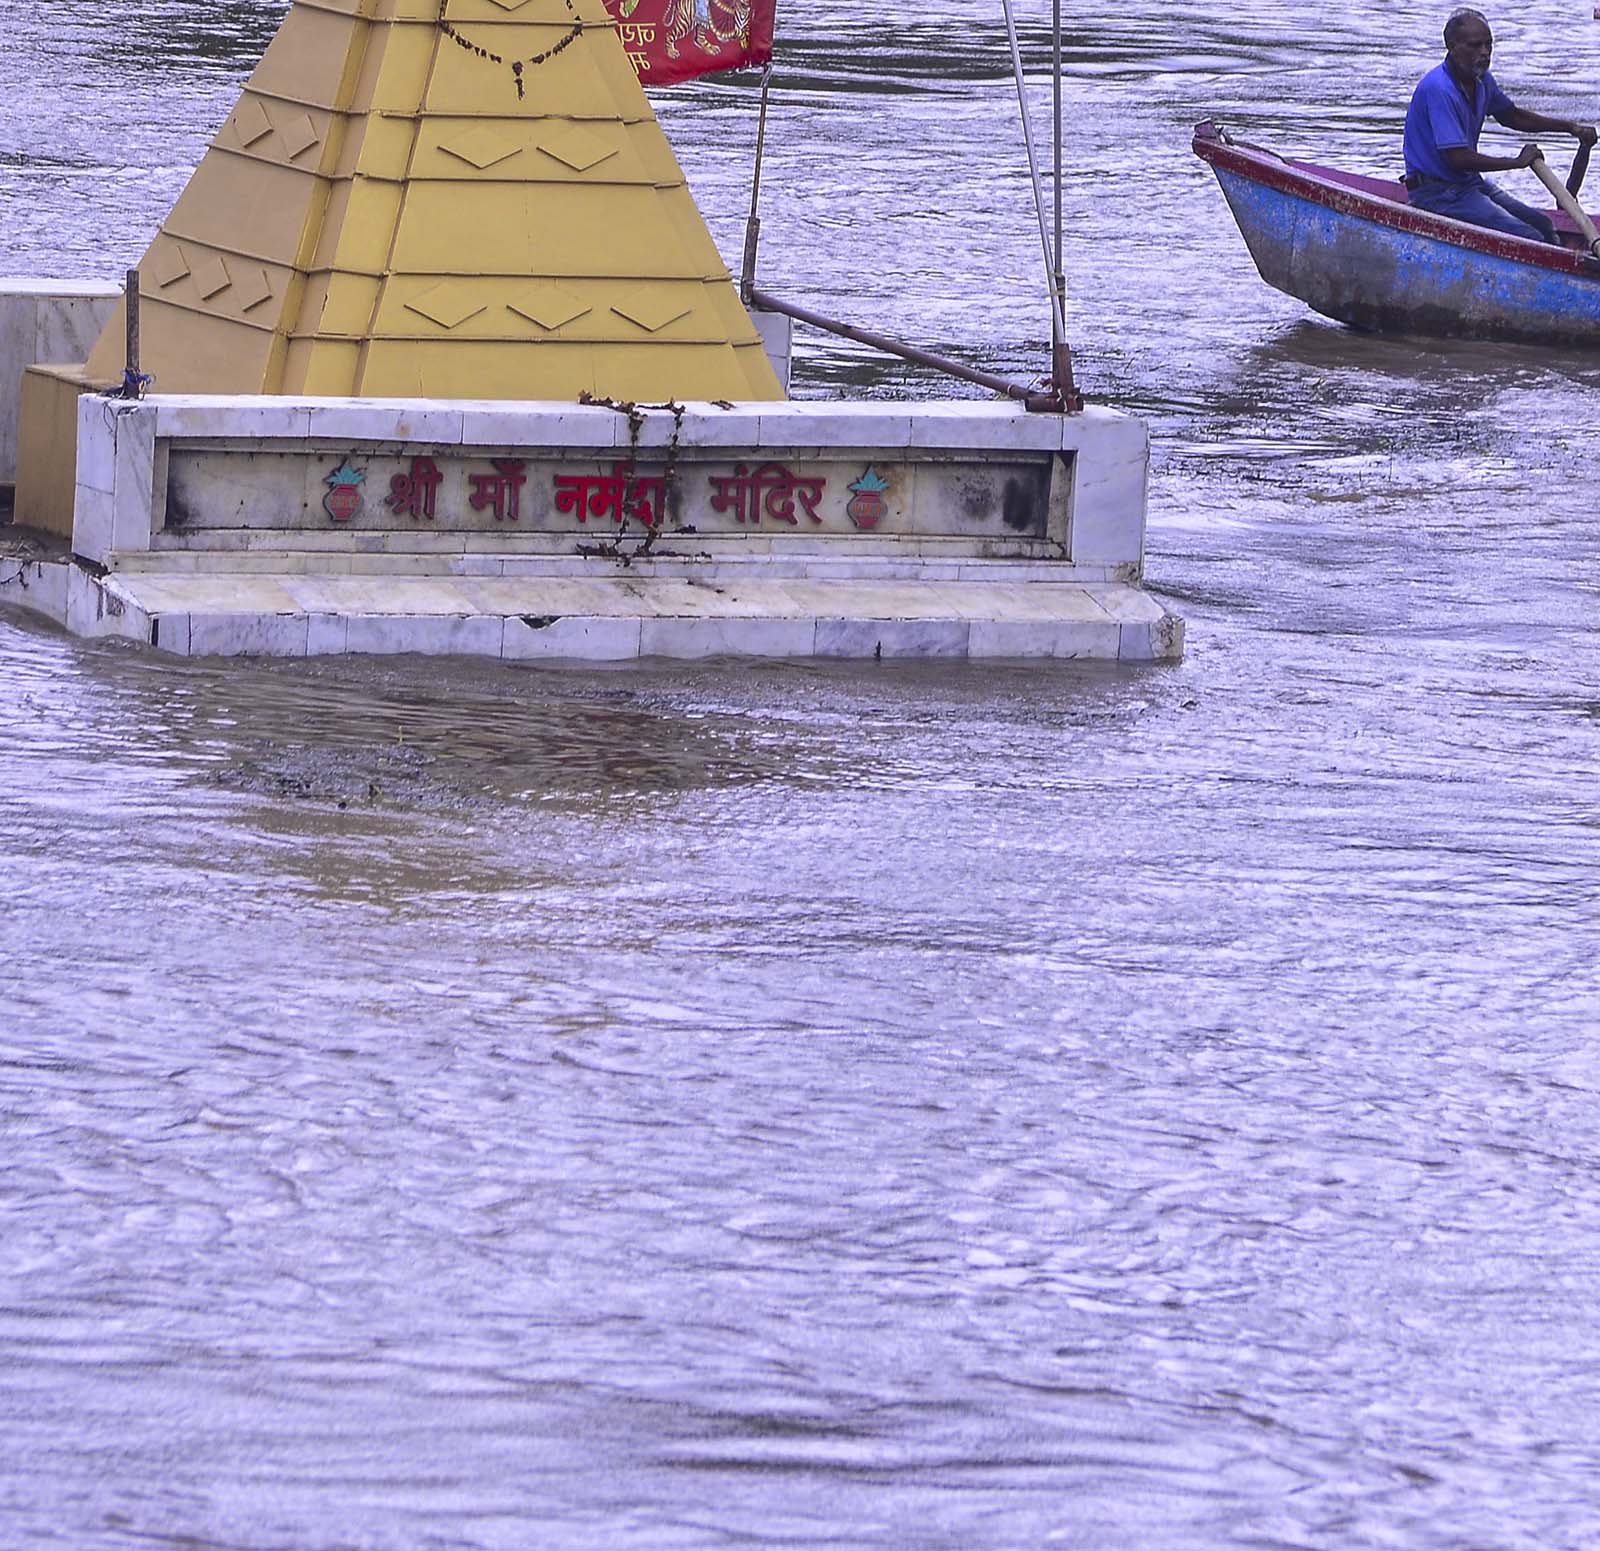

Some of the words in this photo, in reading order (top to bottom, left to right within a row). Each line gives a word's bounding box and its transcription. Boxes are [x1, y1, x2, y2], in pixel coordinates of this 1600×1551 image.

[384, 454, 443, 521] श्री
[554, 459, 665, 526] नर्मदा
[708, 462, 826, 525] मंदिर
